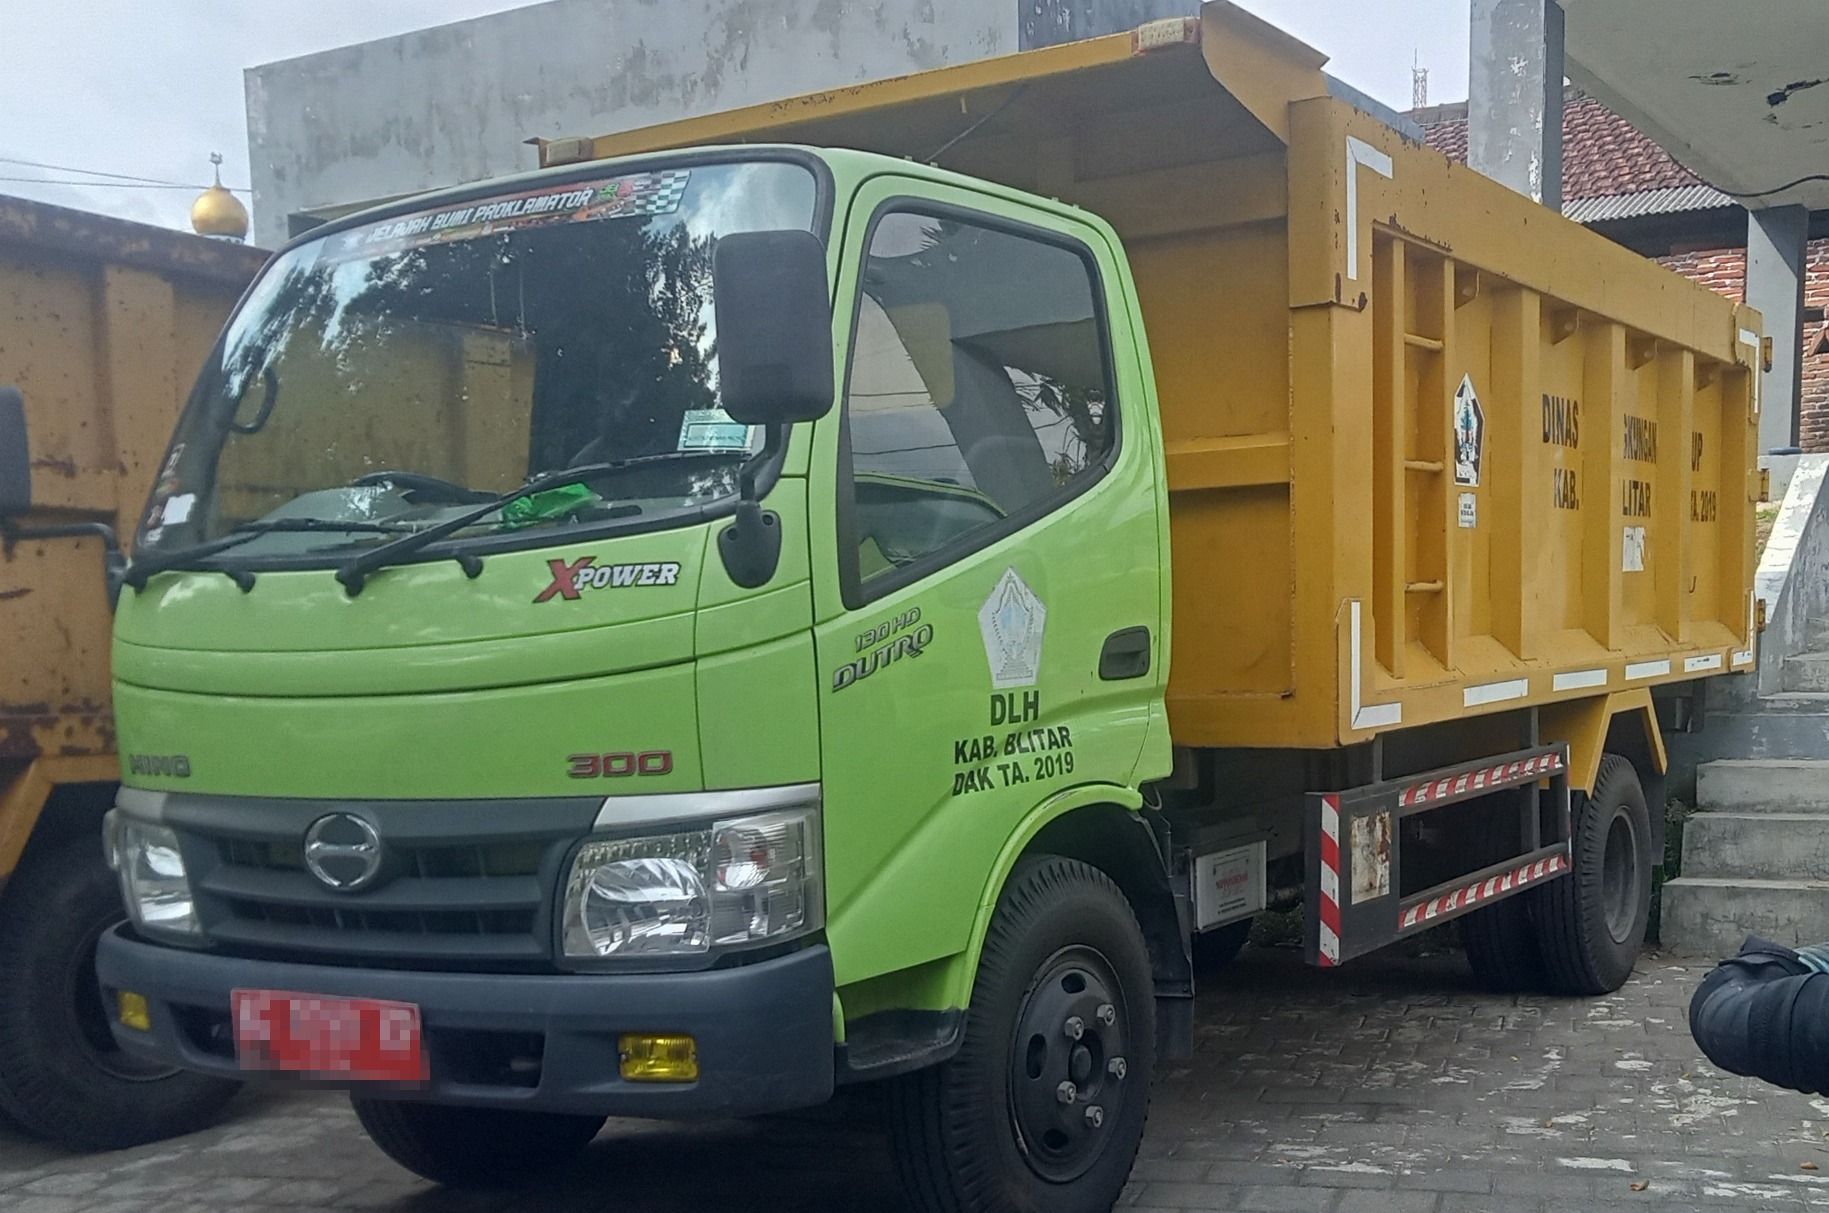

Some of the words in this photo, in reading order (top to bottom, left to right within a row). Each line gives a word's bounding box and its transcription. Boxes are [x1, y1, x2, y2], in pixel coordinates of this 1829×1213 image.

[430, 208, 475, 231] BUMI
[471, 188, 595, 224] PROKLAMATOR
[1542, 393, 1578, 450] DINAS
[1554, 468, 1580, 510] KAB.
[1700, 490, 1717, 521] 2019
[855, 621, 890, 653] 130
[892, 606, 921, 635] HD
[832, 623, 933, 694] DUTRO
[990, 690, 1039, 726] DLH
[567, 750, 674, 779] 300
[954, 735, 998, 765] KAB.
[1003, 725, 1073, 756] BLITAR
[952, 766, 995, 797] DAK
[996, 761, 1030, 787] TA.
[1033, 751, 1074, 781] 2019
